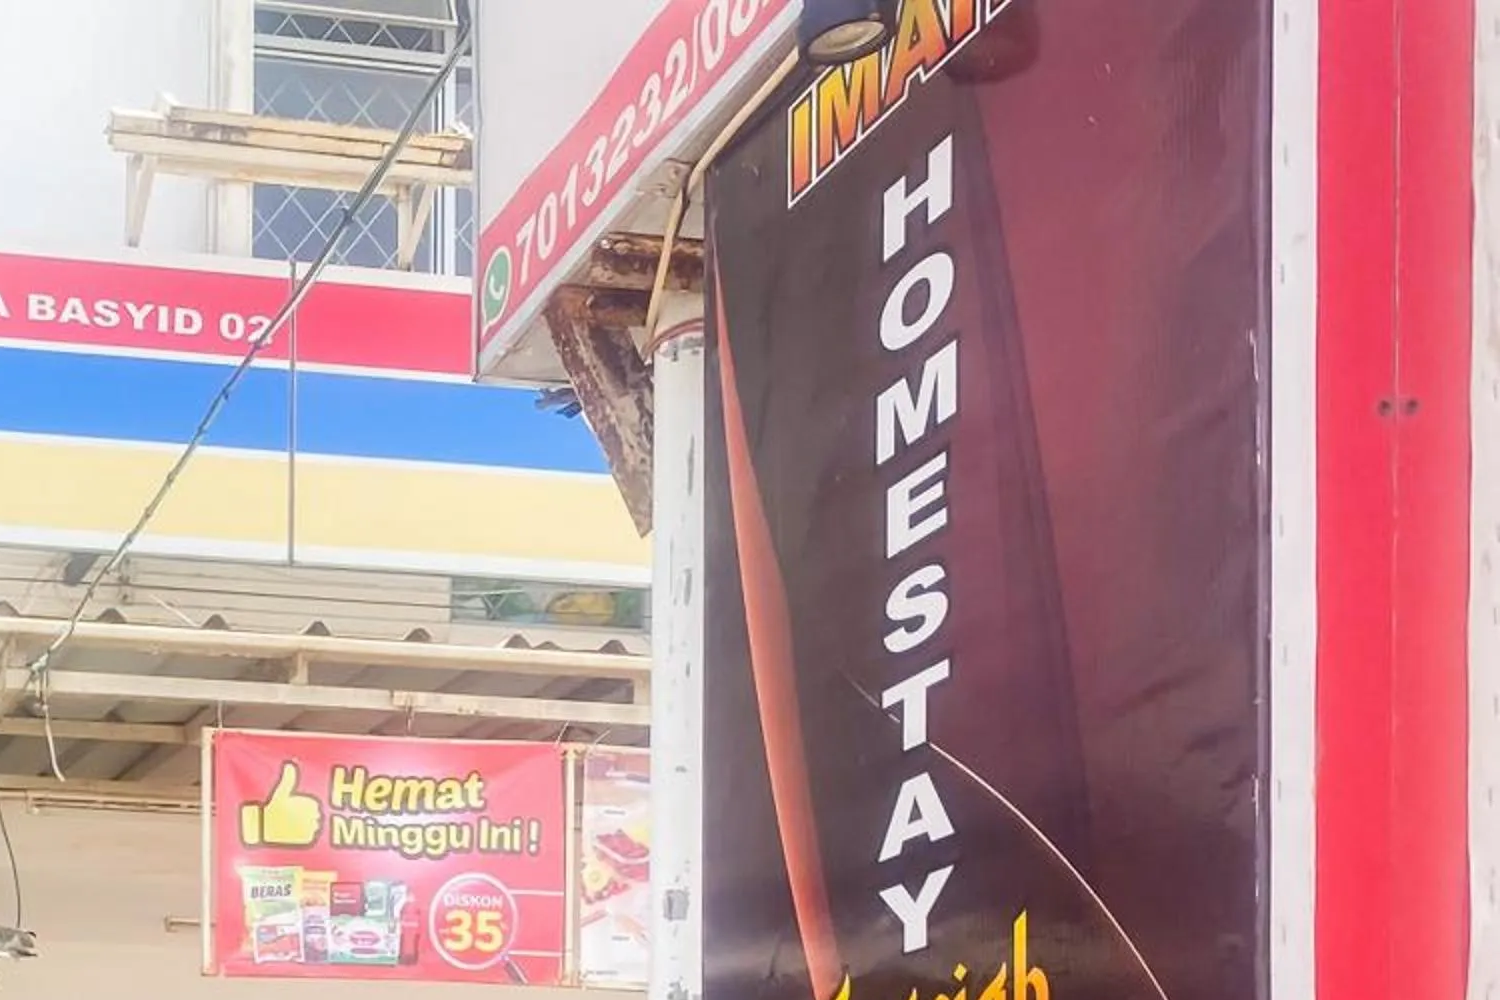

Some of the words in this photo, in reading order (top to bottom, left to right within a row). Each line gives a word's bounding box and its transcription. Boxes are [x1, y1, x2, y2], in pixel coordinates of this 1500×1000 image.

[515, 0, 770, 286] 7013232/0
[26, 293, 204, 336] BASYID
[218, 312, 274, 345] 02
[875, 133, 959, 954] HOMESTAY
[330, 765, 486, 813] Hemat
[331, 815, 472, 857] Minggu
[477, 817, 522, 854] Ini
[250, 883, 292, 900] BERAS
[443, 892, 504, 909] DISKON
[444, 908, 504, 953] 35
